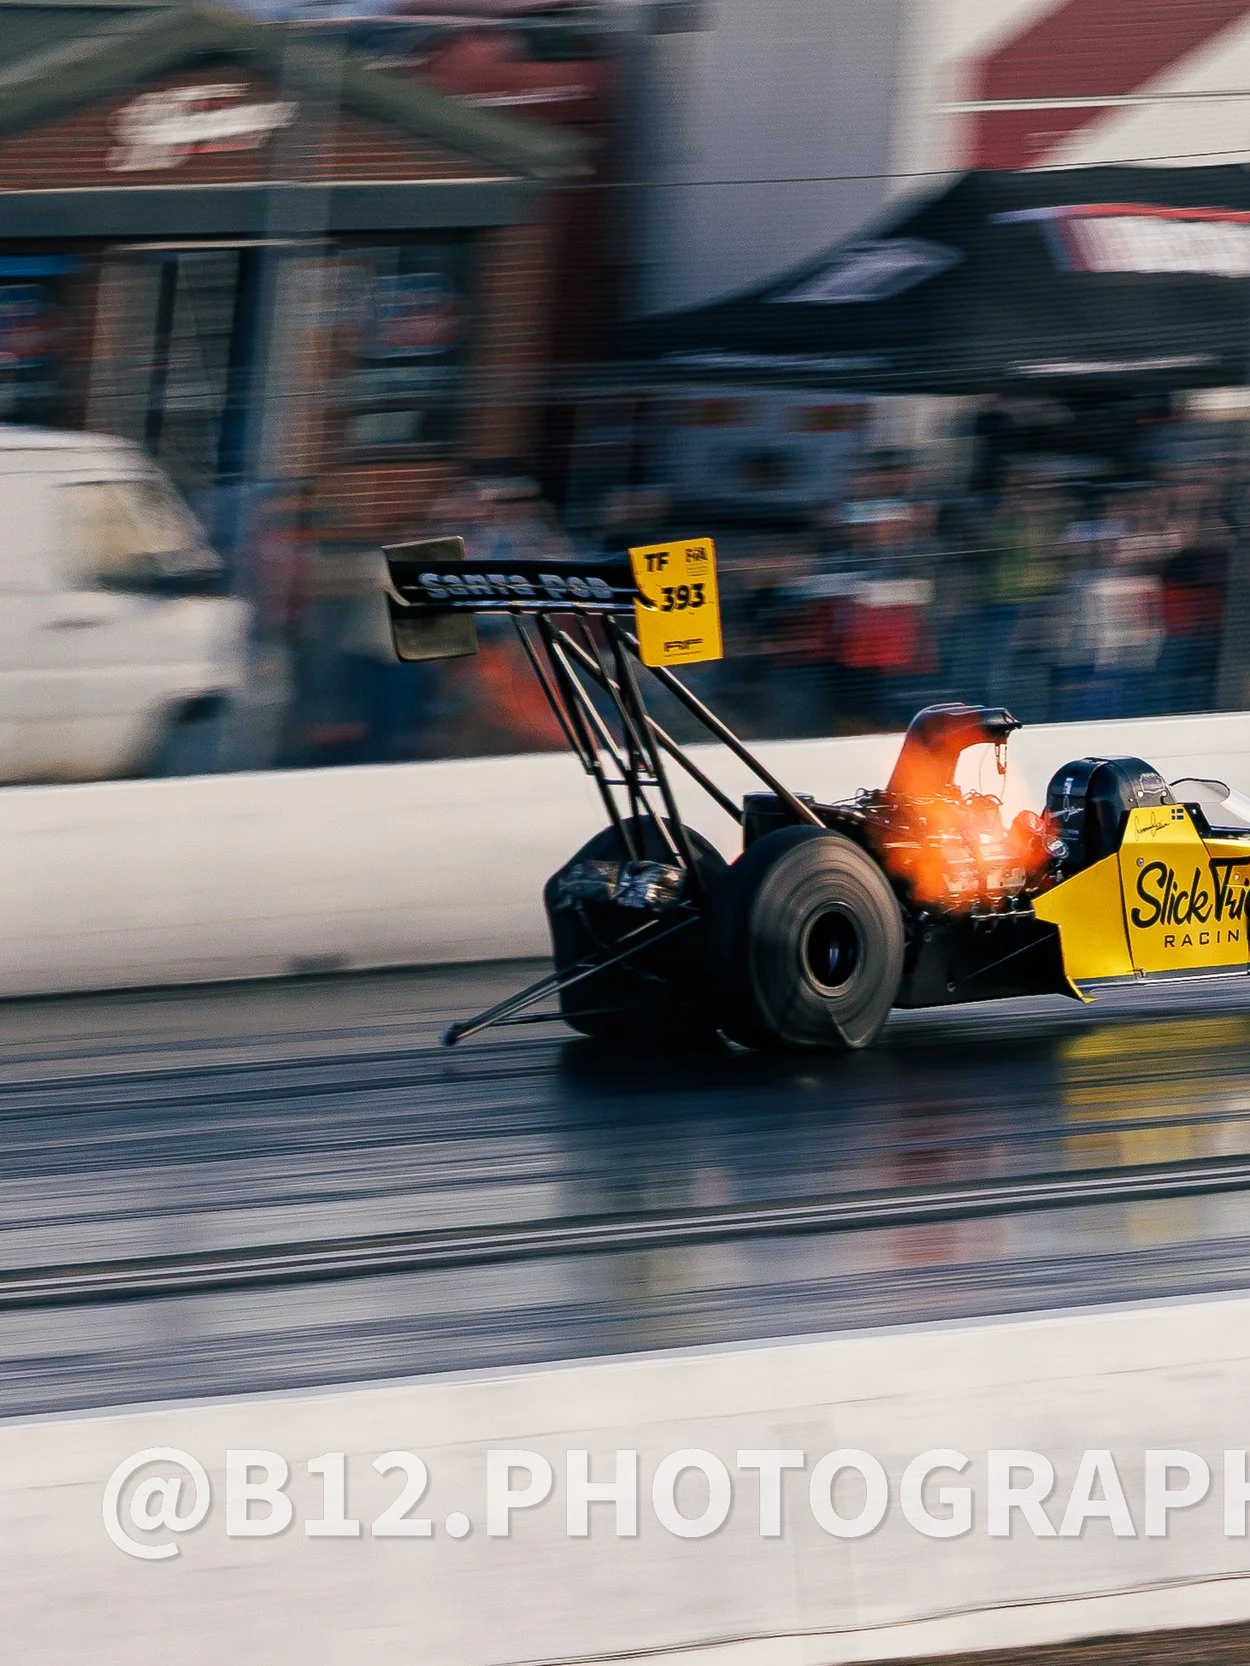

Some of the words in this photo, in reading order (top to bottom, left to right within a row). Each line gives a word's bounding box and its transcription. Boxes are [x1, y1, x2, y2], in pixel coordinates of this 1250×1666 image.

[643, 552, 670, 573] TF
[660, 583, 705, 613] 393
[1131, 861, 1213, 929] Slick
